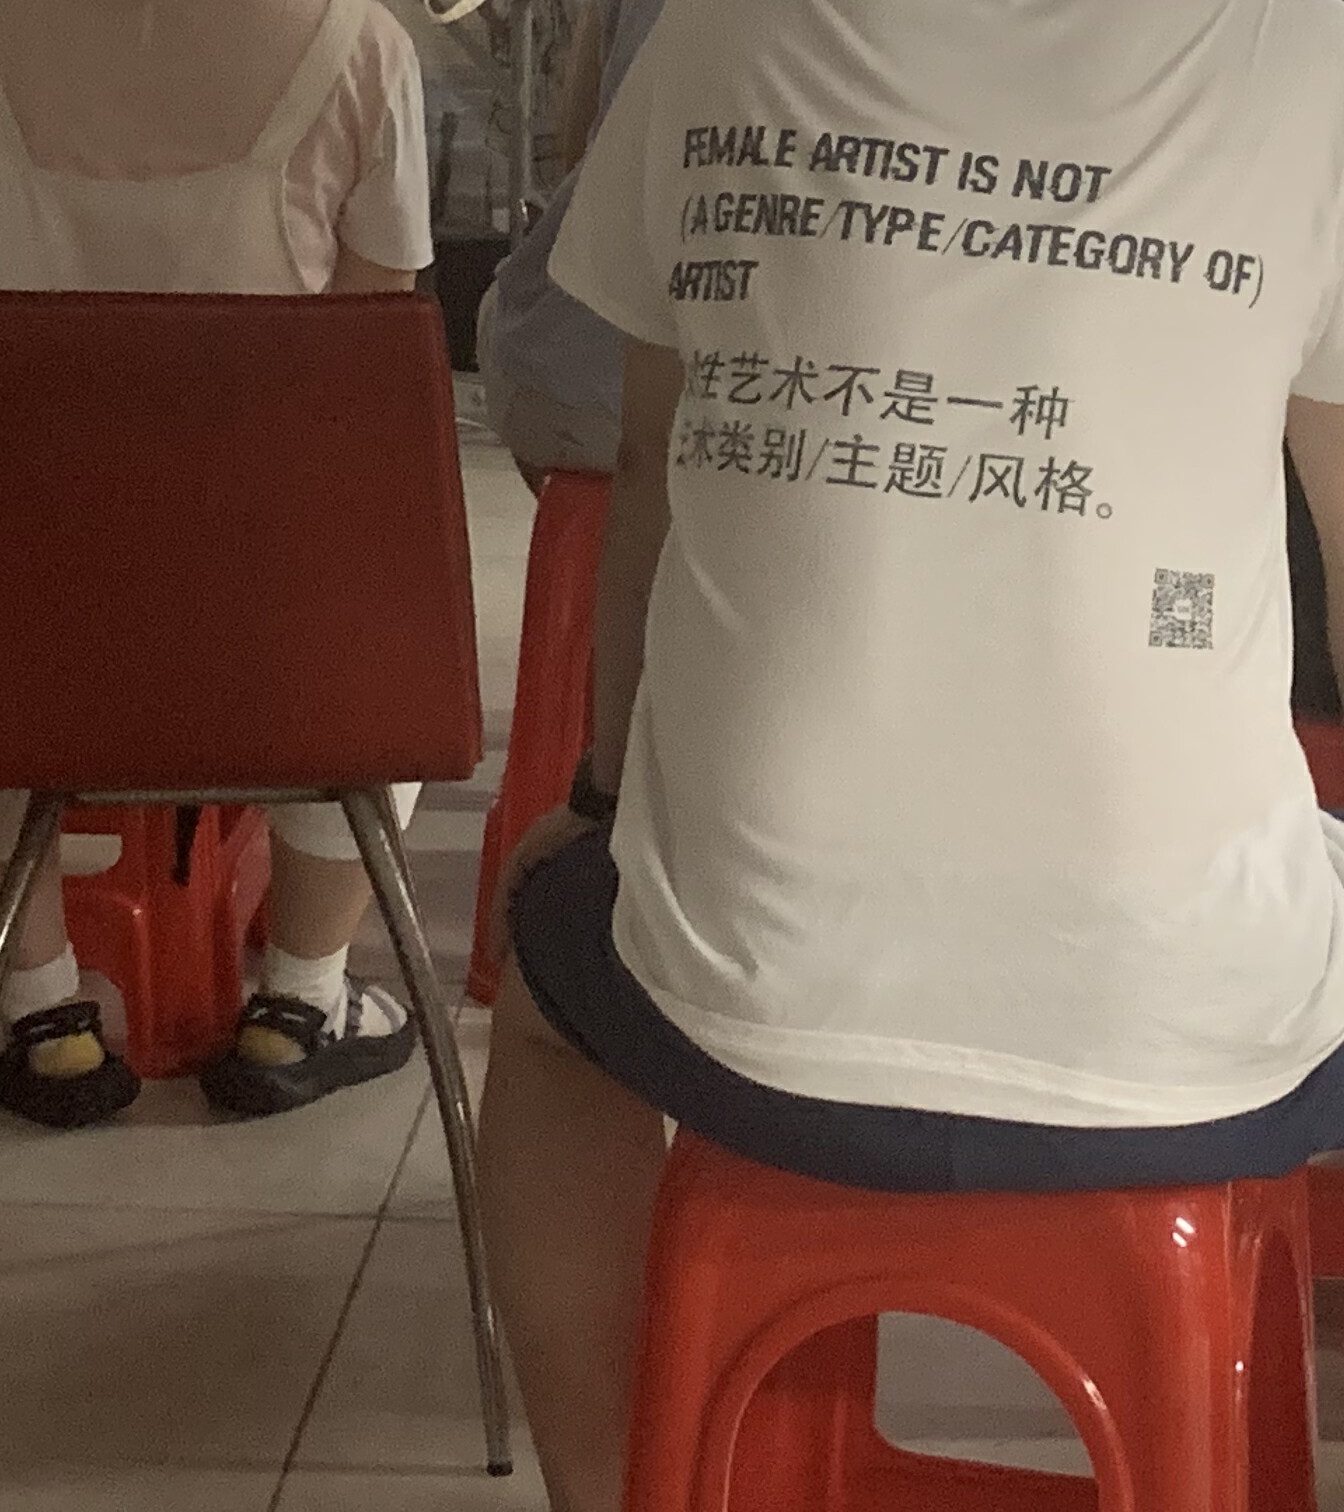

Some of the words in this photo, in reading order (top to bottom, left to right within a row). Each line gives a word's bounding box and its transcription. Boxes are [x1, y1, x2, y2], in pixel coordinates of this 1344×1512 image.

[682, 125, 797, 169] FEMALE
[809, 132, 950, 186] ARTIST
[957, 151, 1000, 195] IS
[1011, 159, 1112, 204] NOT
[668, 258, 760, 301] ARTIST
[680, 193, 707, 245] (A
[1204, 249, 1264, 310] OF)
[676, 419, 1114, 520] 术类别/主题/风格。
